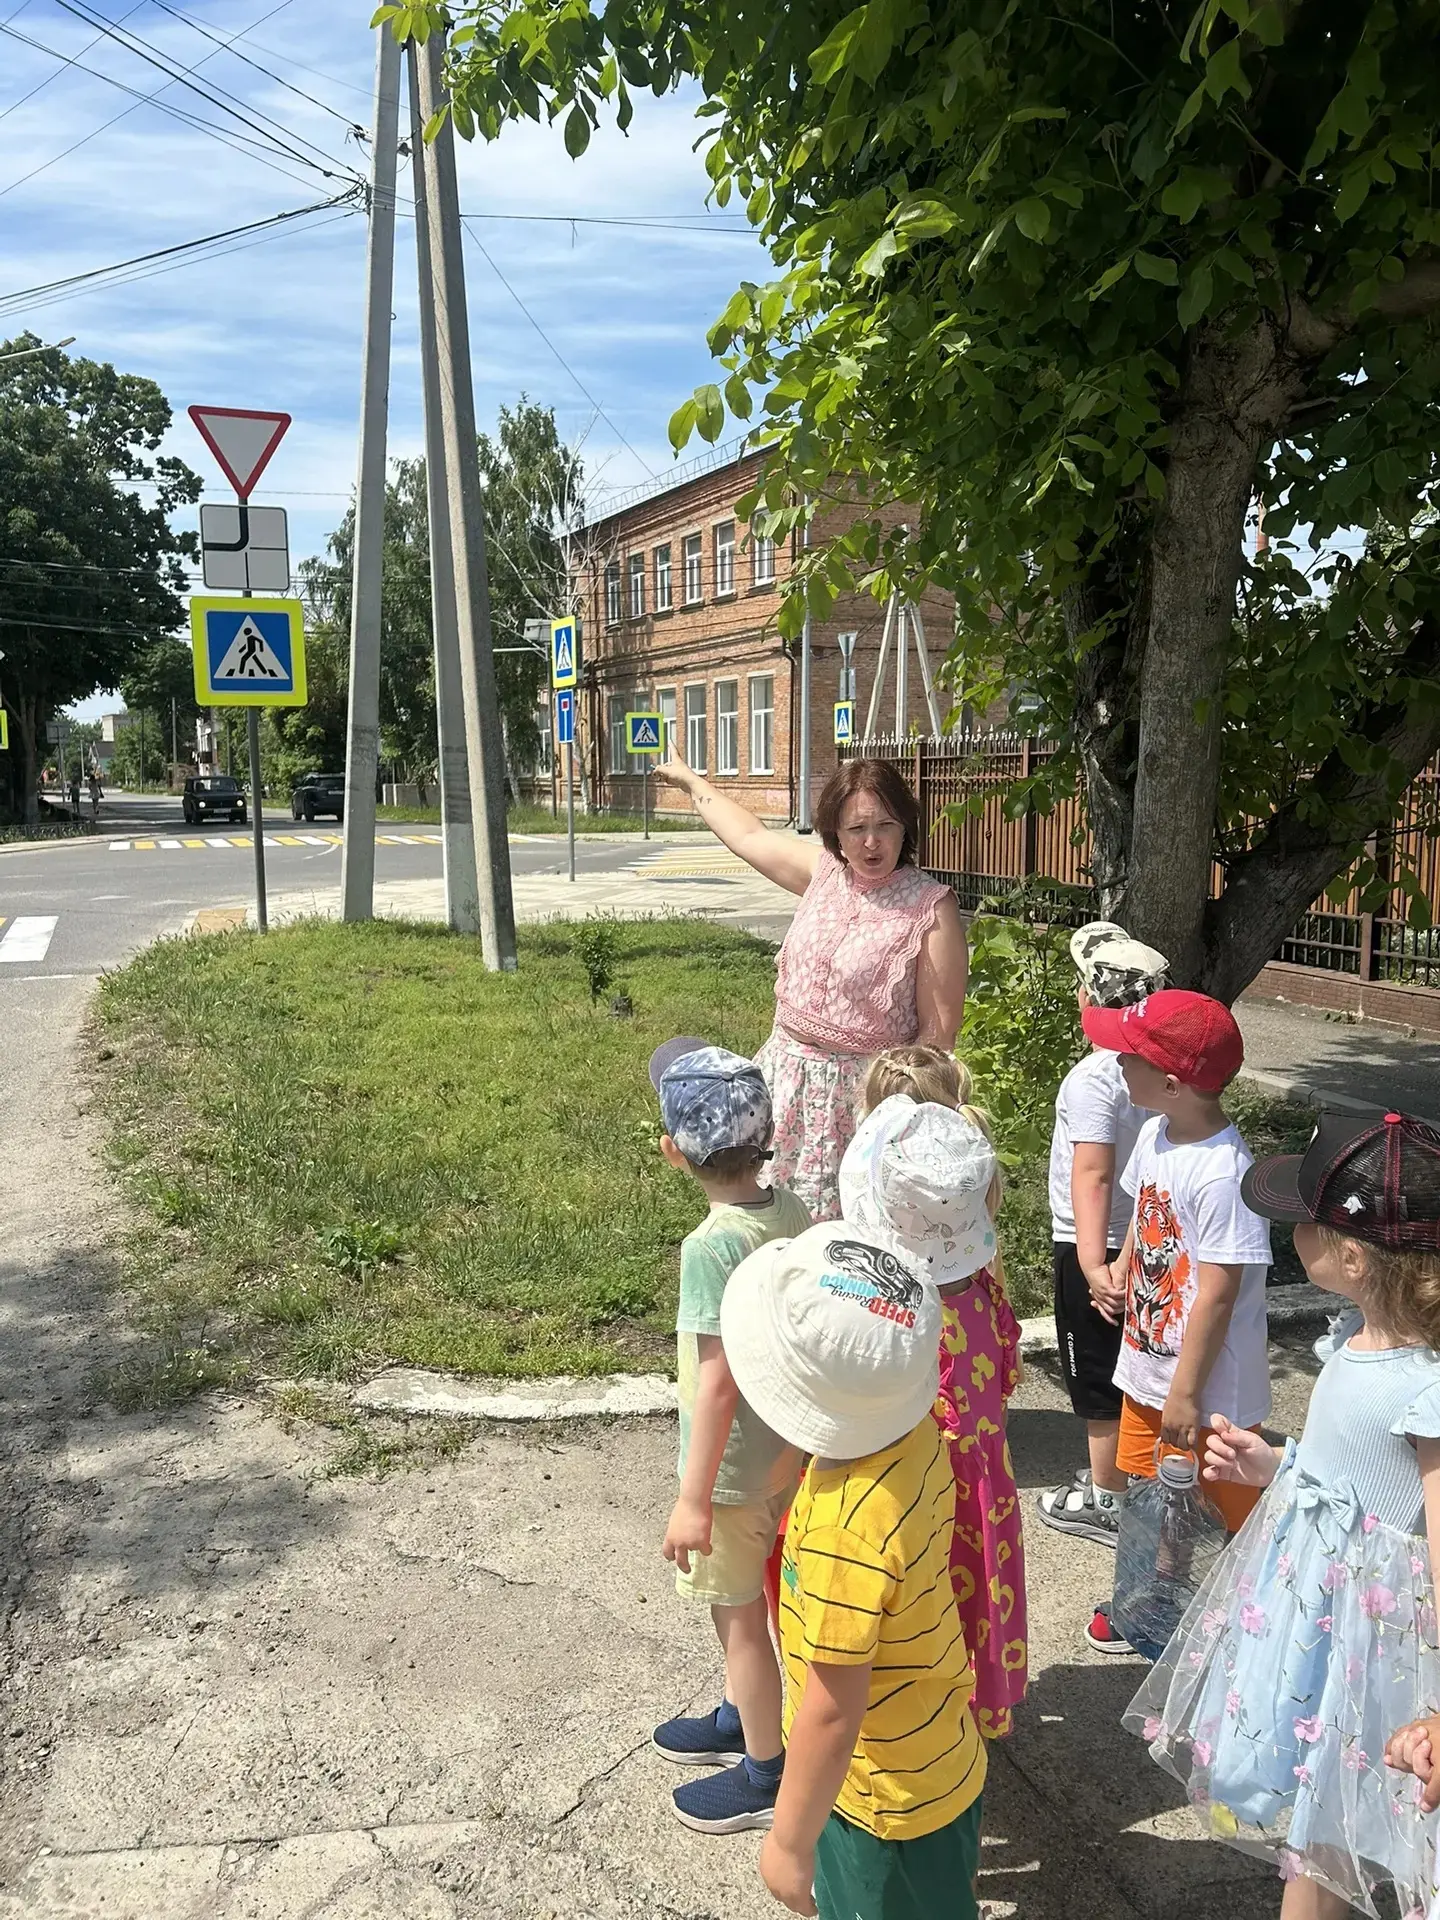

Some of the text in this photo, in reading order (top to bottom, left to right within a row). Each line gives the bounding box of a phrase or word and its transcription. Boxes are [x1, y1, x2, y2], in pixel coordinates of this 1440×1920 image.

[820, 1274, 879, 1298] MONACO
[828, 1283, 916, 1329] SPEED Racing
